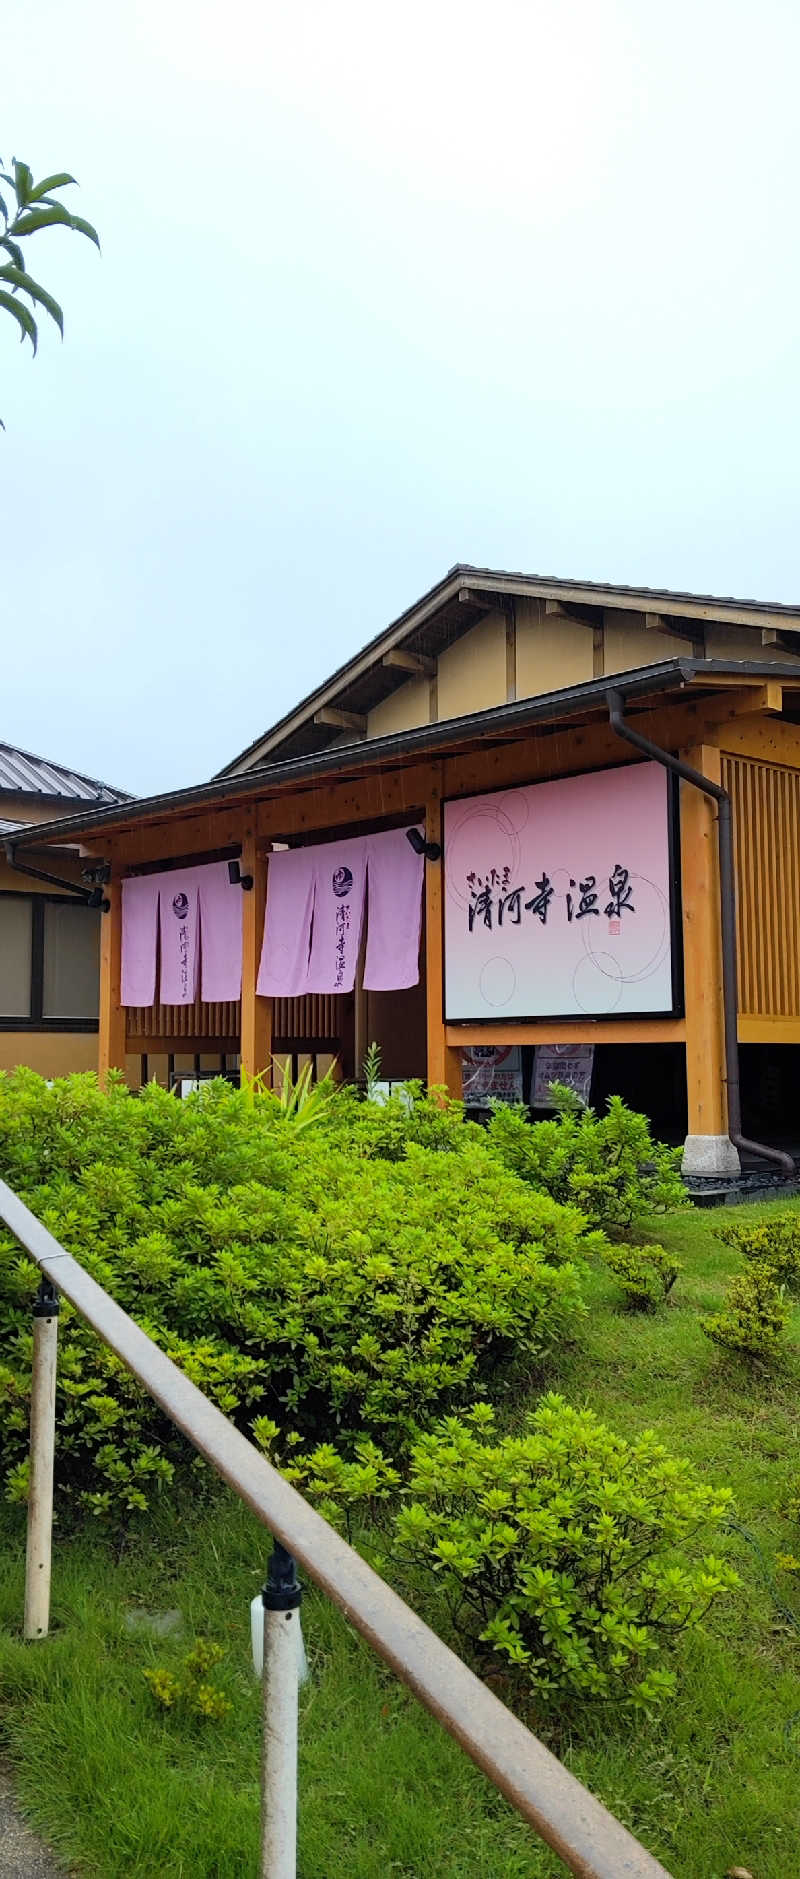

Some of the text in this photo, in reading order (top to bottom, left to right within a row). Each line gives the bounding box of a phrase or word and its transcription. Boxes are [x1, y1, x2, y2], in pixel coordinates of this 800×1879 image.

[466, 866, 511, 892] さいたま
[468, 864, 635, 932] 清河寺温泉
